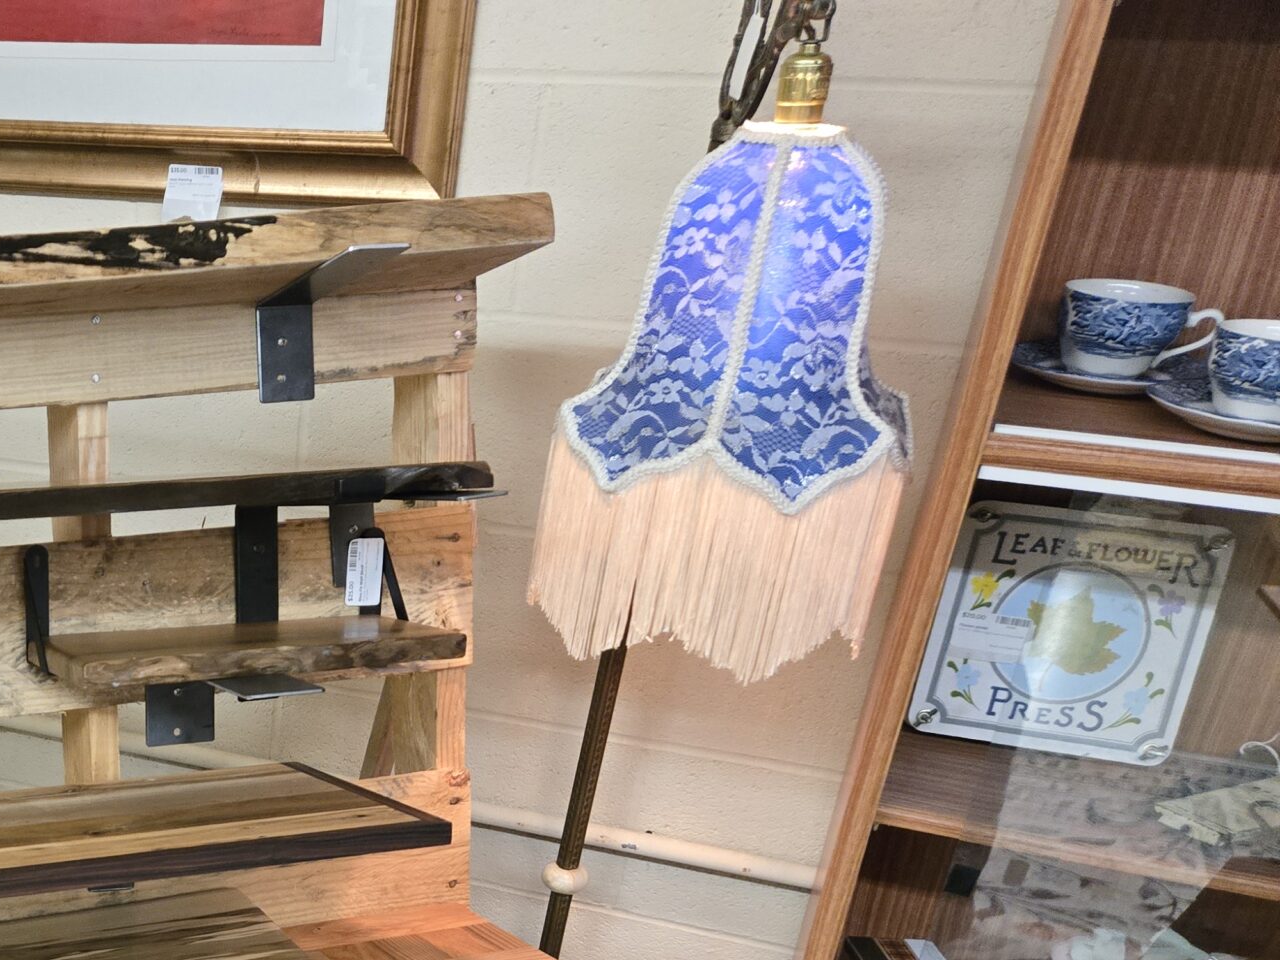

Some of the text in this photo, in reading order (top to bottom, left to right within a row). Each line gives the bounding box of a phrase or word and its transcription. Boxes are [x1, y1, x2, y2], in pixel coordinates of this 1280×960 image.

[991, 531, 1066, 566] LEAF
[1084, 541, 1201, 588] FLOWER
[985, 686, 1108, 733] PRESS
